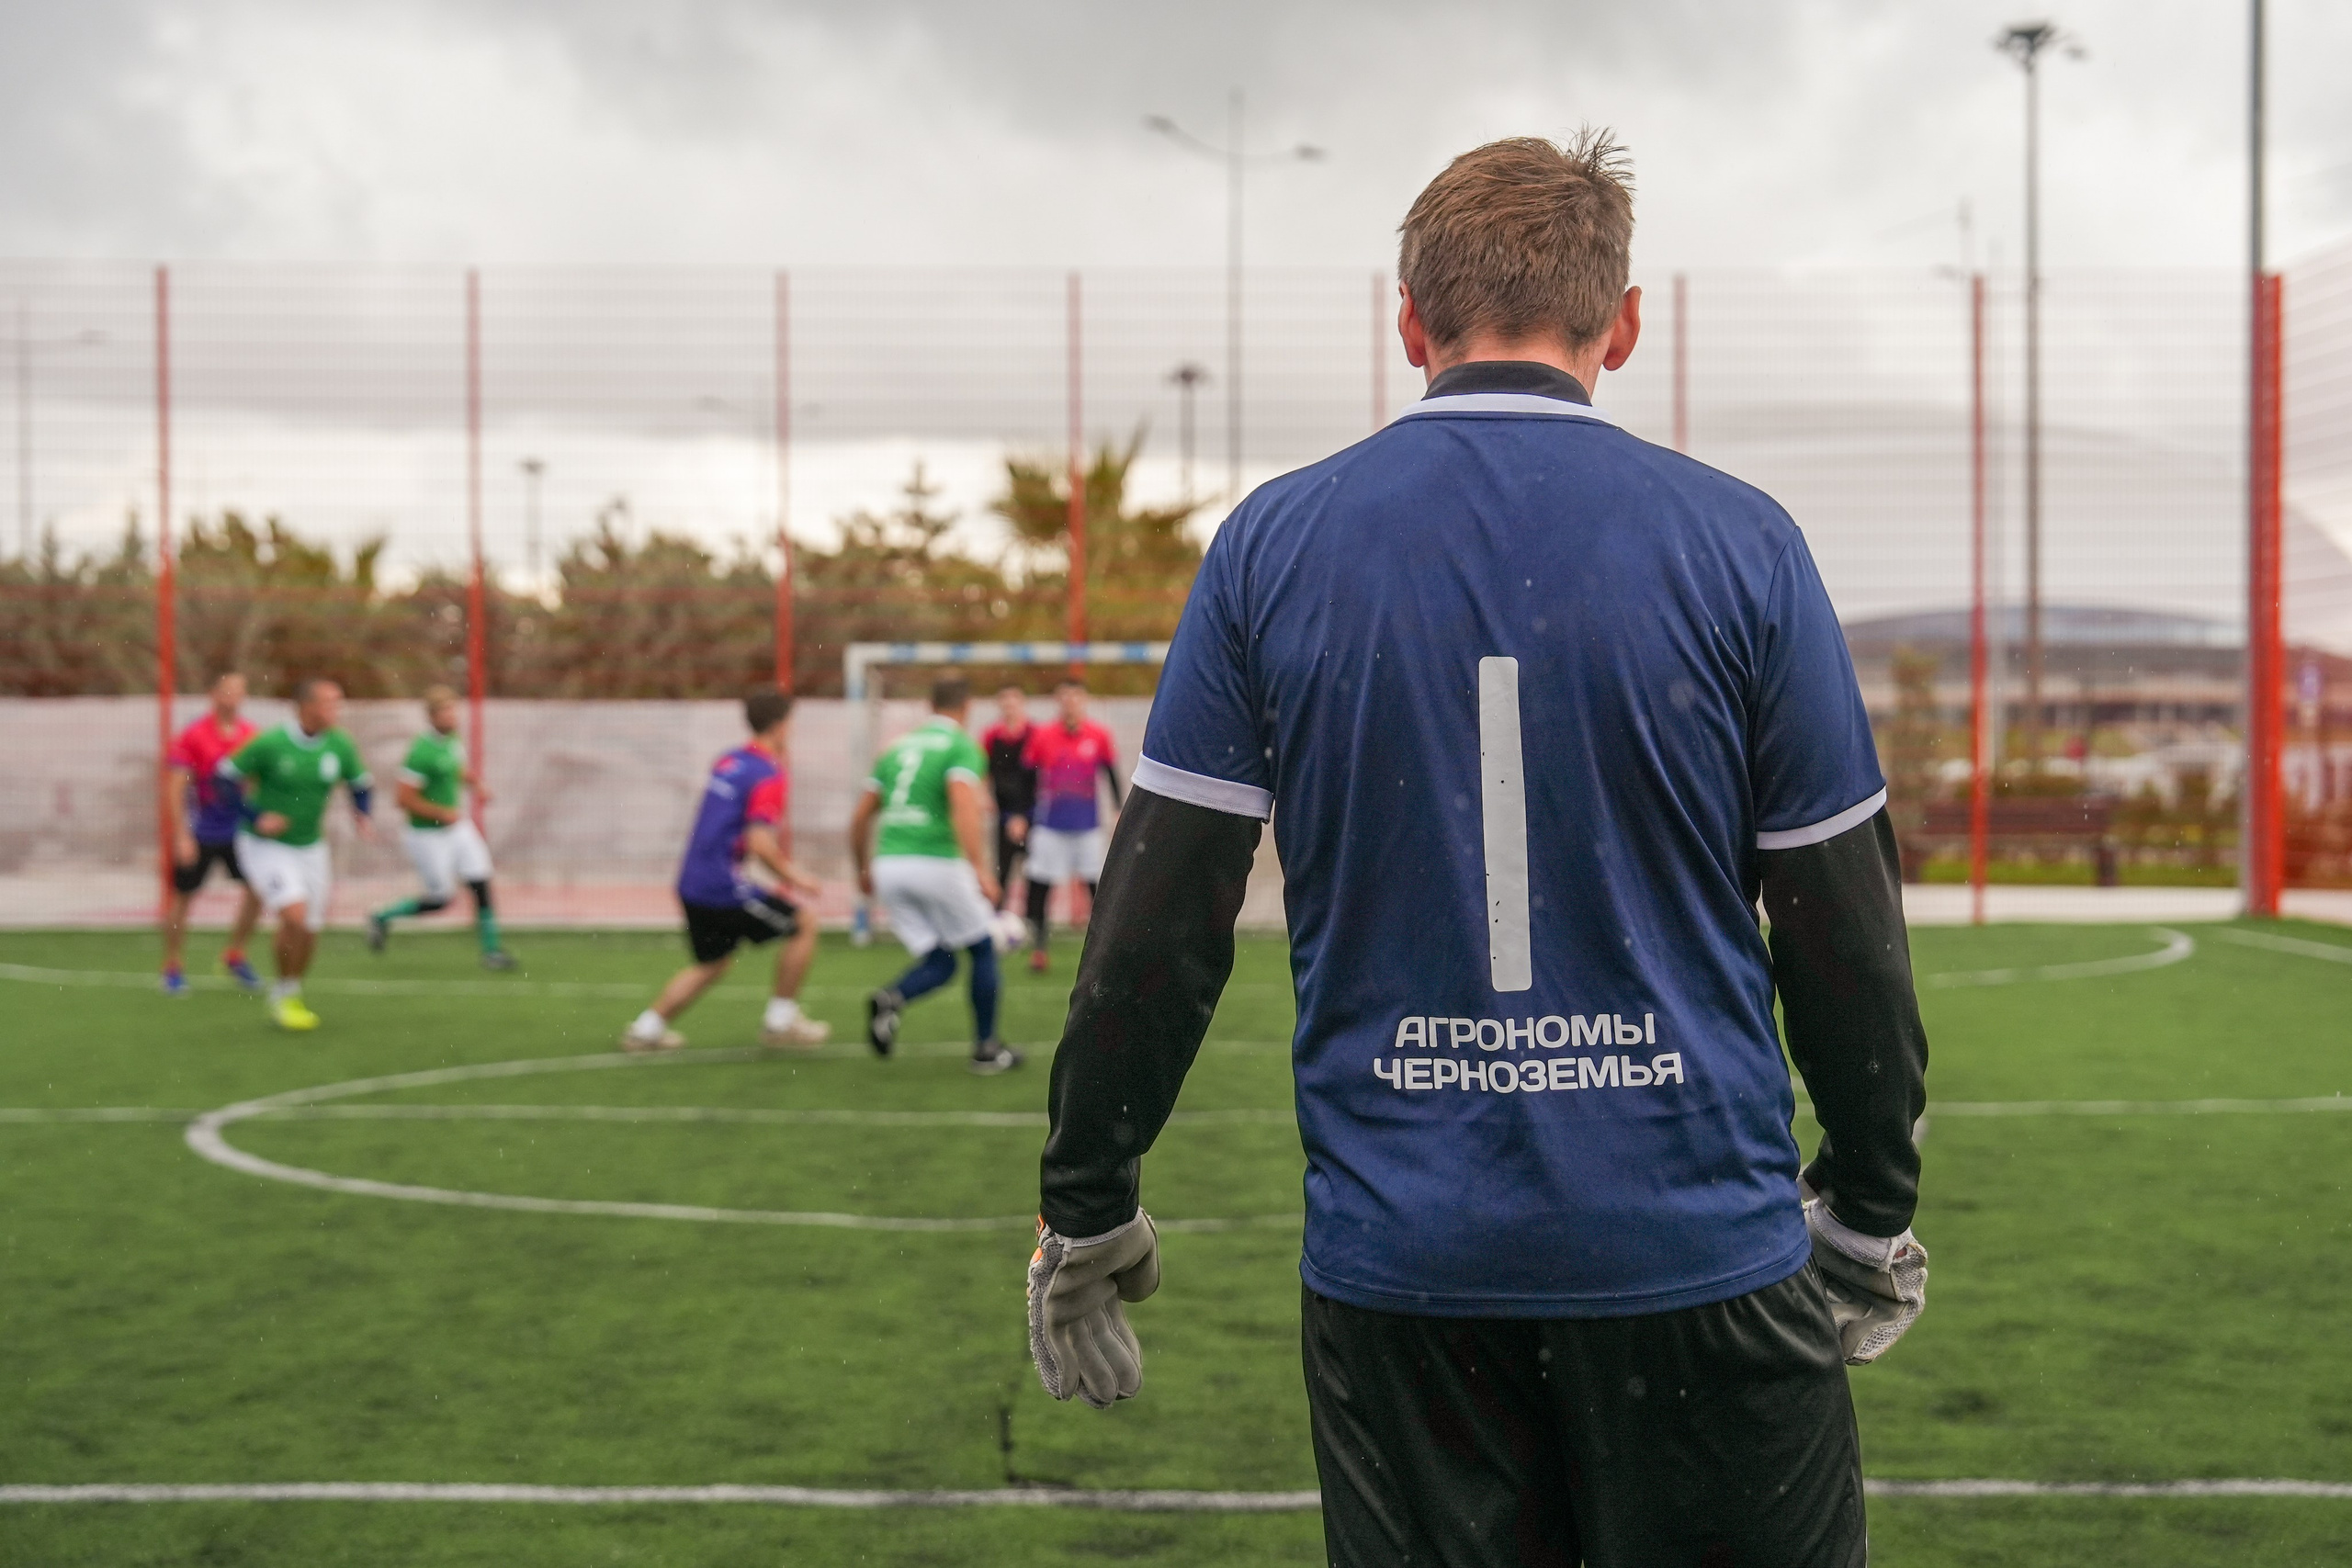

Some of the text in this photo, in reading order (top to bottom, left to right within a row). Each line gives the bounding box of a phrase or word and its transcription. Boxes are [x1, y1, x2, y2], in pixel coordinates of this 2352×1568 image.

[1478, 656, 1532, 993] 1
[1395, 1012, 1657, 1052] АГРОНОМЫ
[1374, 1053, 1685, 1094] ЧЕРНОЗЕМЬЯ
